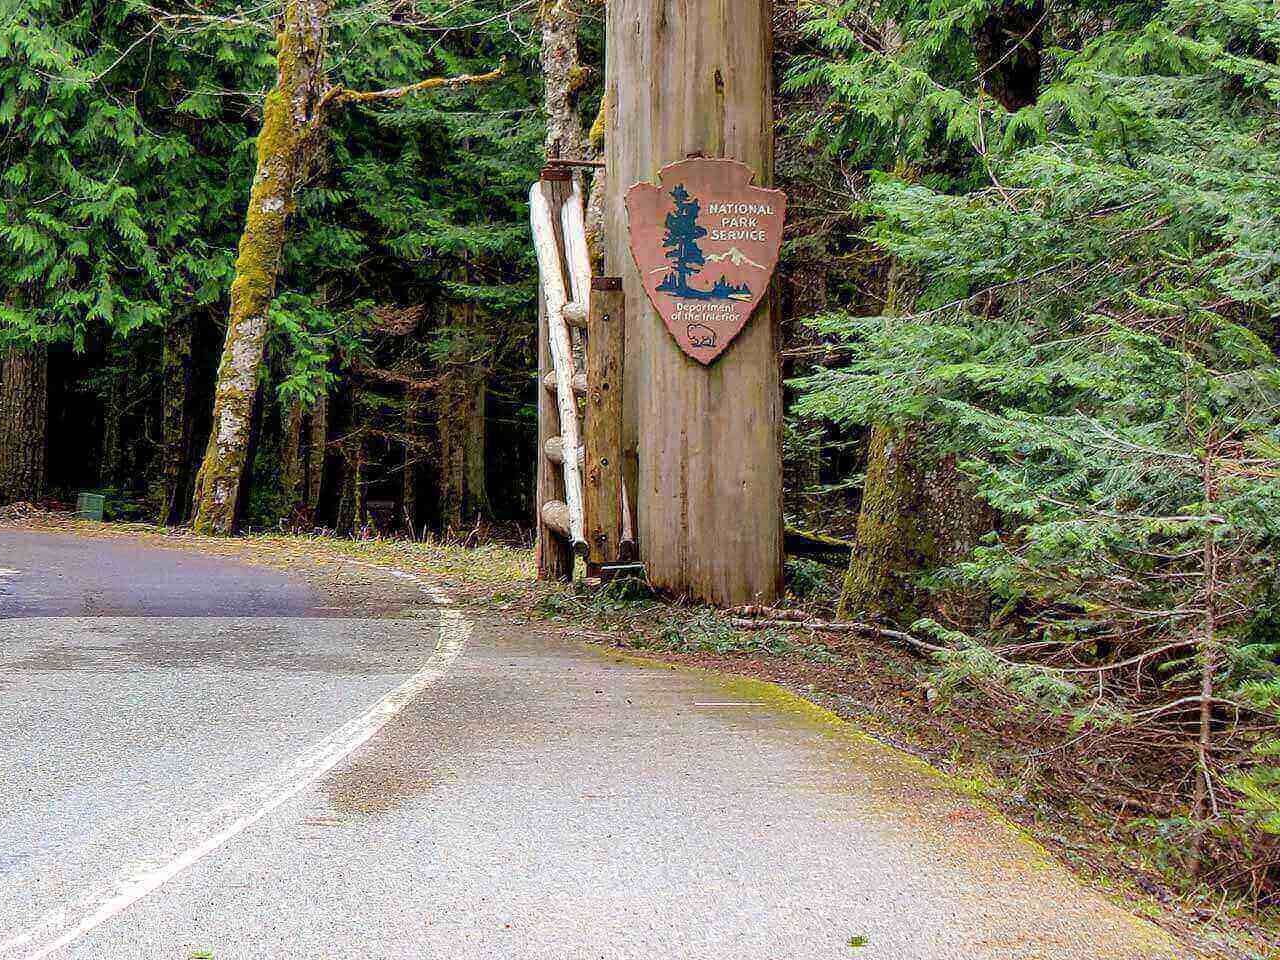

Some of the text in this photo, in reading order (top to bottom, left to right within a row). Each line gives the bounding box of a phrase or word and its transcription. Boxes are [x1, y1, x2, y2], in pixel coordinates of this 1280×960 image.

[709, 203, 774, 215] NATIONAL
[721, 217, 758, 228] PARK
[710, 229, 766, 241] SERVICE
[676, 302, 735, 313] Department
[671, 312, 741, 321] of the Interior
